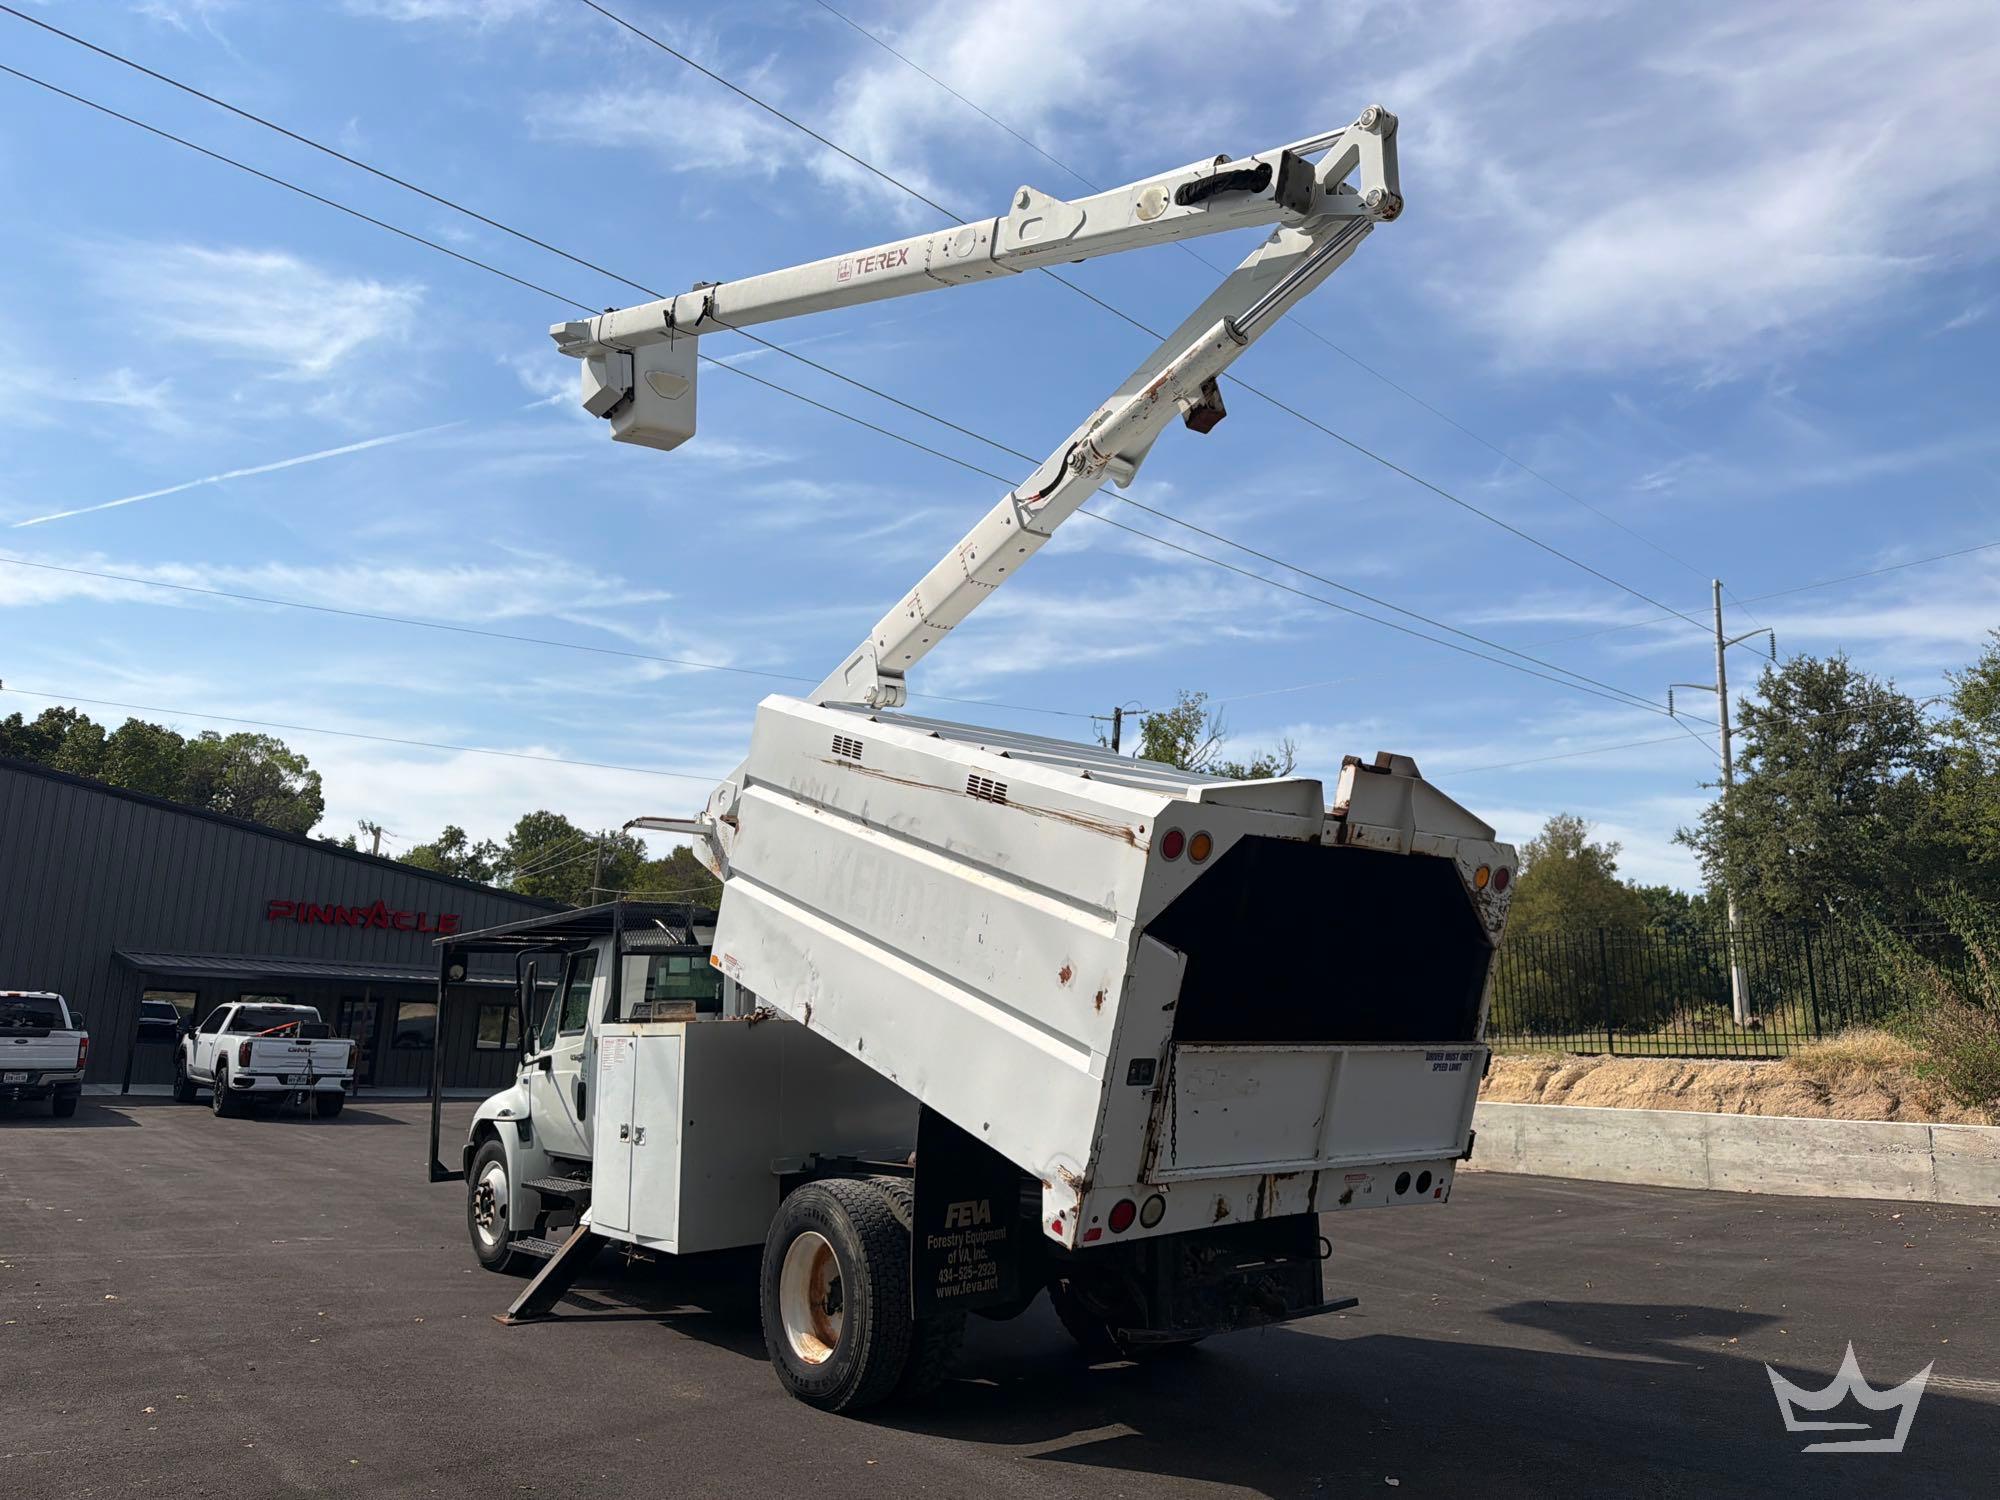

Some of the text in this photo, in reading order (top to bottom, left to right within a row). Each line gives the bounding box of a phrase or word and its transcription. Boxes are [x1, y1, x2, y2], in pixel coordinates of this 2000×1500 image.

[856, 247, 910, 275] TEREX
[268, 898, 461, 934] PINNACLE
[1432, 1062, 1462, 1072] SPEED LIMIT
[944, 1199, 991, 1229] FEVA
[927, 1227, 1007, 1250] Forestry Equipment
[948, 1249, 957, 1264] of
[973, 1247, 988, 1261] Inc.
[938, 1262, 997, 1284] 434-525-2929
[936, 1276, 999, 1298] www.feva.net
